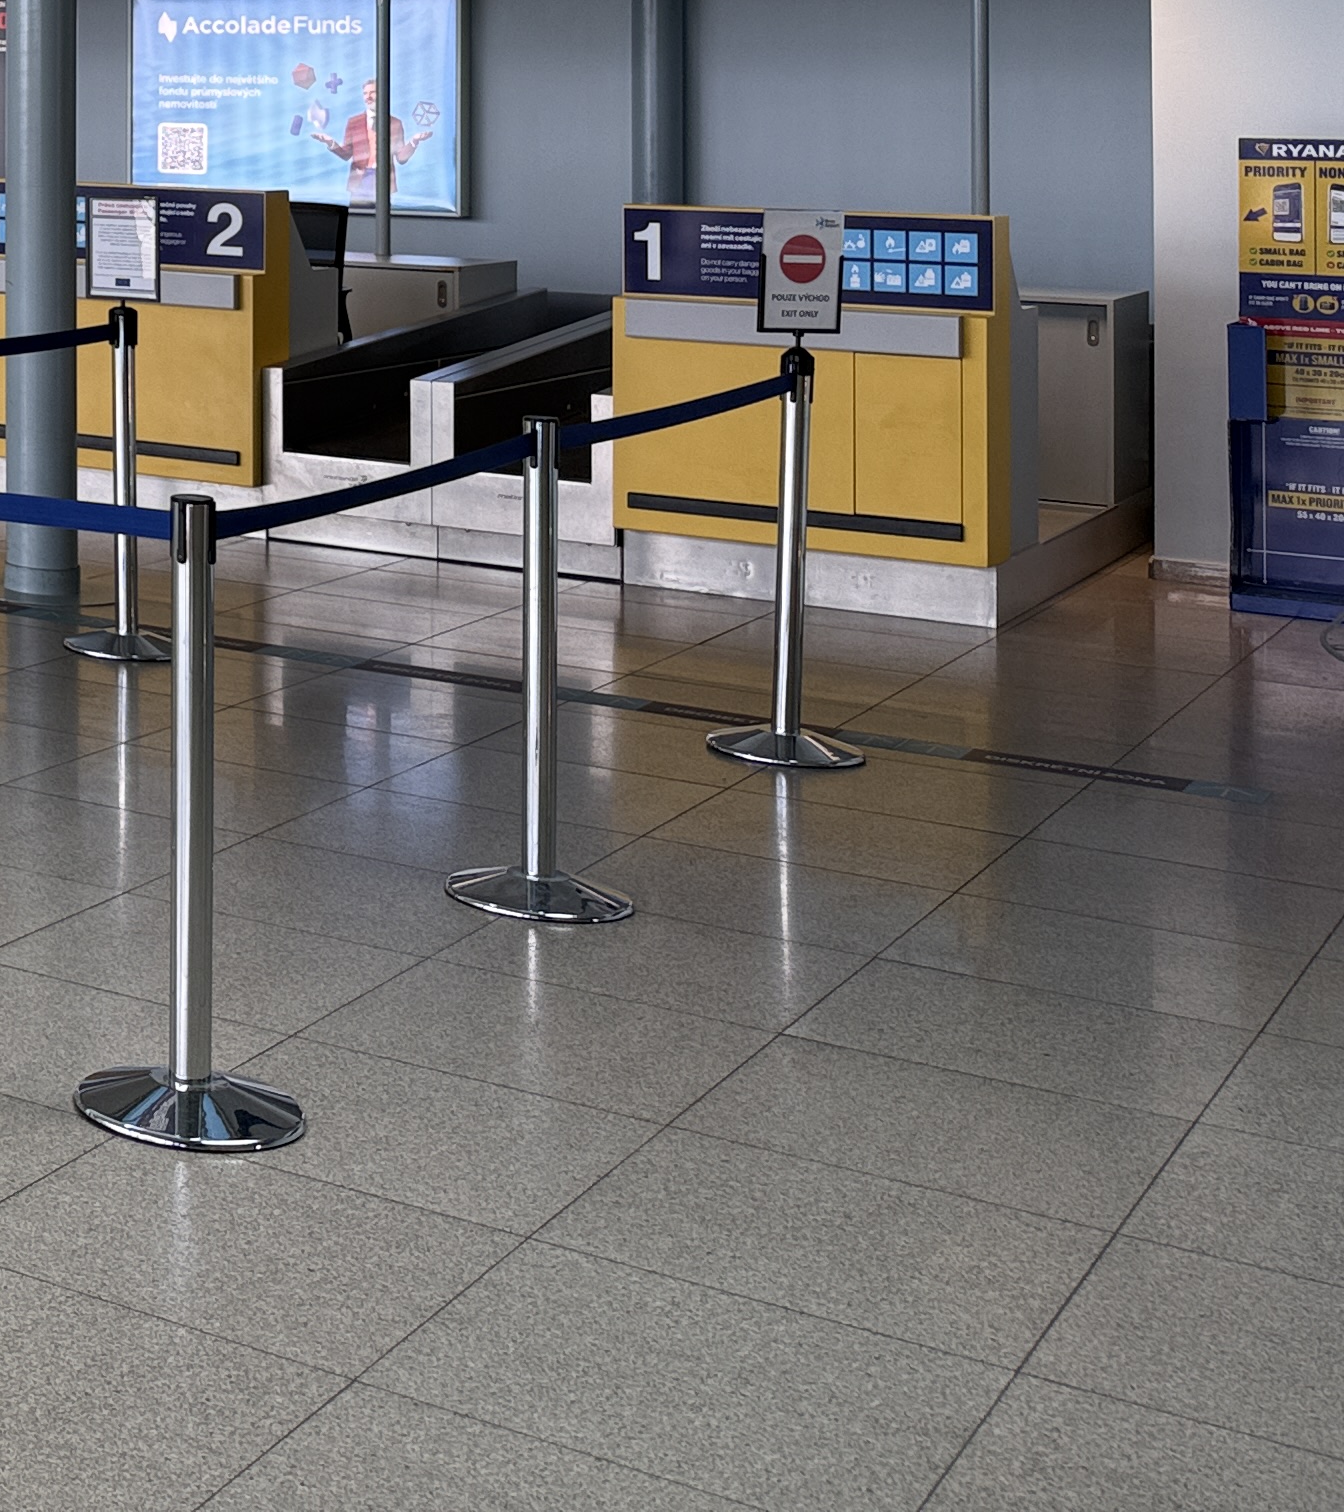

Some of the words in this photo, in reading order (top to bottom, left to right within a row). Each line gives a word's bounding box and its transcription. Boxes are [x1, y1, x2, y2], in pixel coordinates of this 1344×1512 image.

[209, 74, 223, 84] do
[1244, 165, 1307, 178] PRIORITY
[206, 202, 244, 257] 2
[633, 221, 661, 281] 1
[1258, 247, 1287, 256] SMALL
[1289, 248, 1306, 256] BAG
[1259, 258, 1284, 267] CABIN
[1286, 259, 1303, 267] BAG
[1261, 280, 1278, 288] YOU
[1279, 280, 1302, 289] CAN'T
[1303, 282, 1329, 291] BRING
[771, 293, 796, 302] POUZE
[798, 292, 830, 303] VÝCHOD
[781, 309, 797, 318] EXIT
[799, 309, 819, 318] ONLY
[1276, 353, 1297, 363] MAX
[1312, 354, 1344, 366] SMALL
[1272, 494, 1294, 505] MAX
